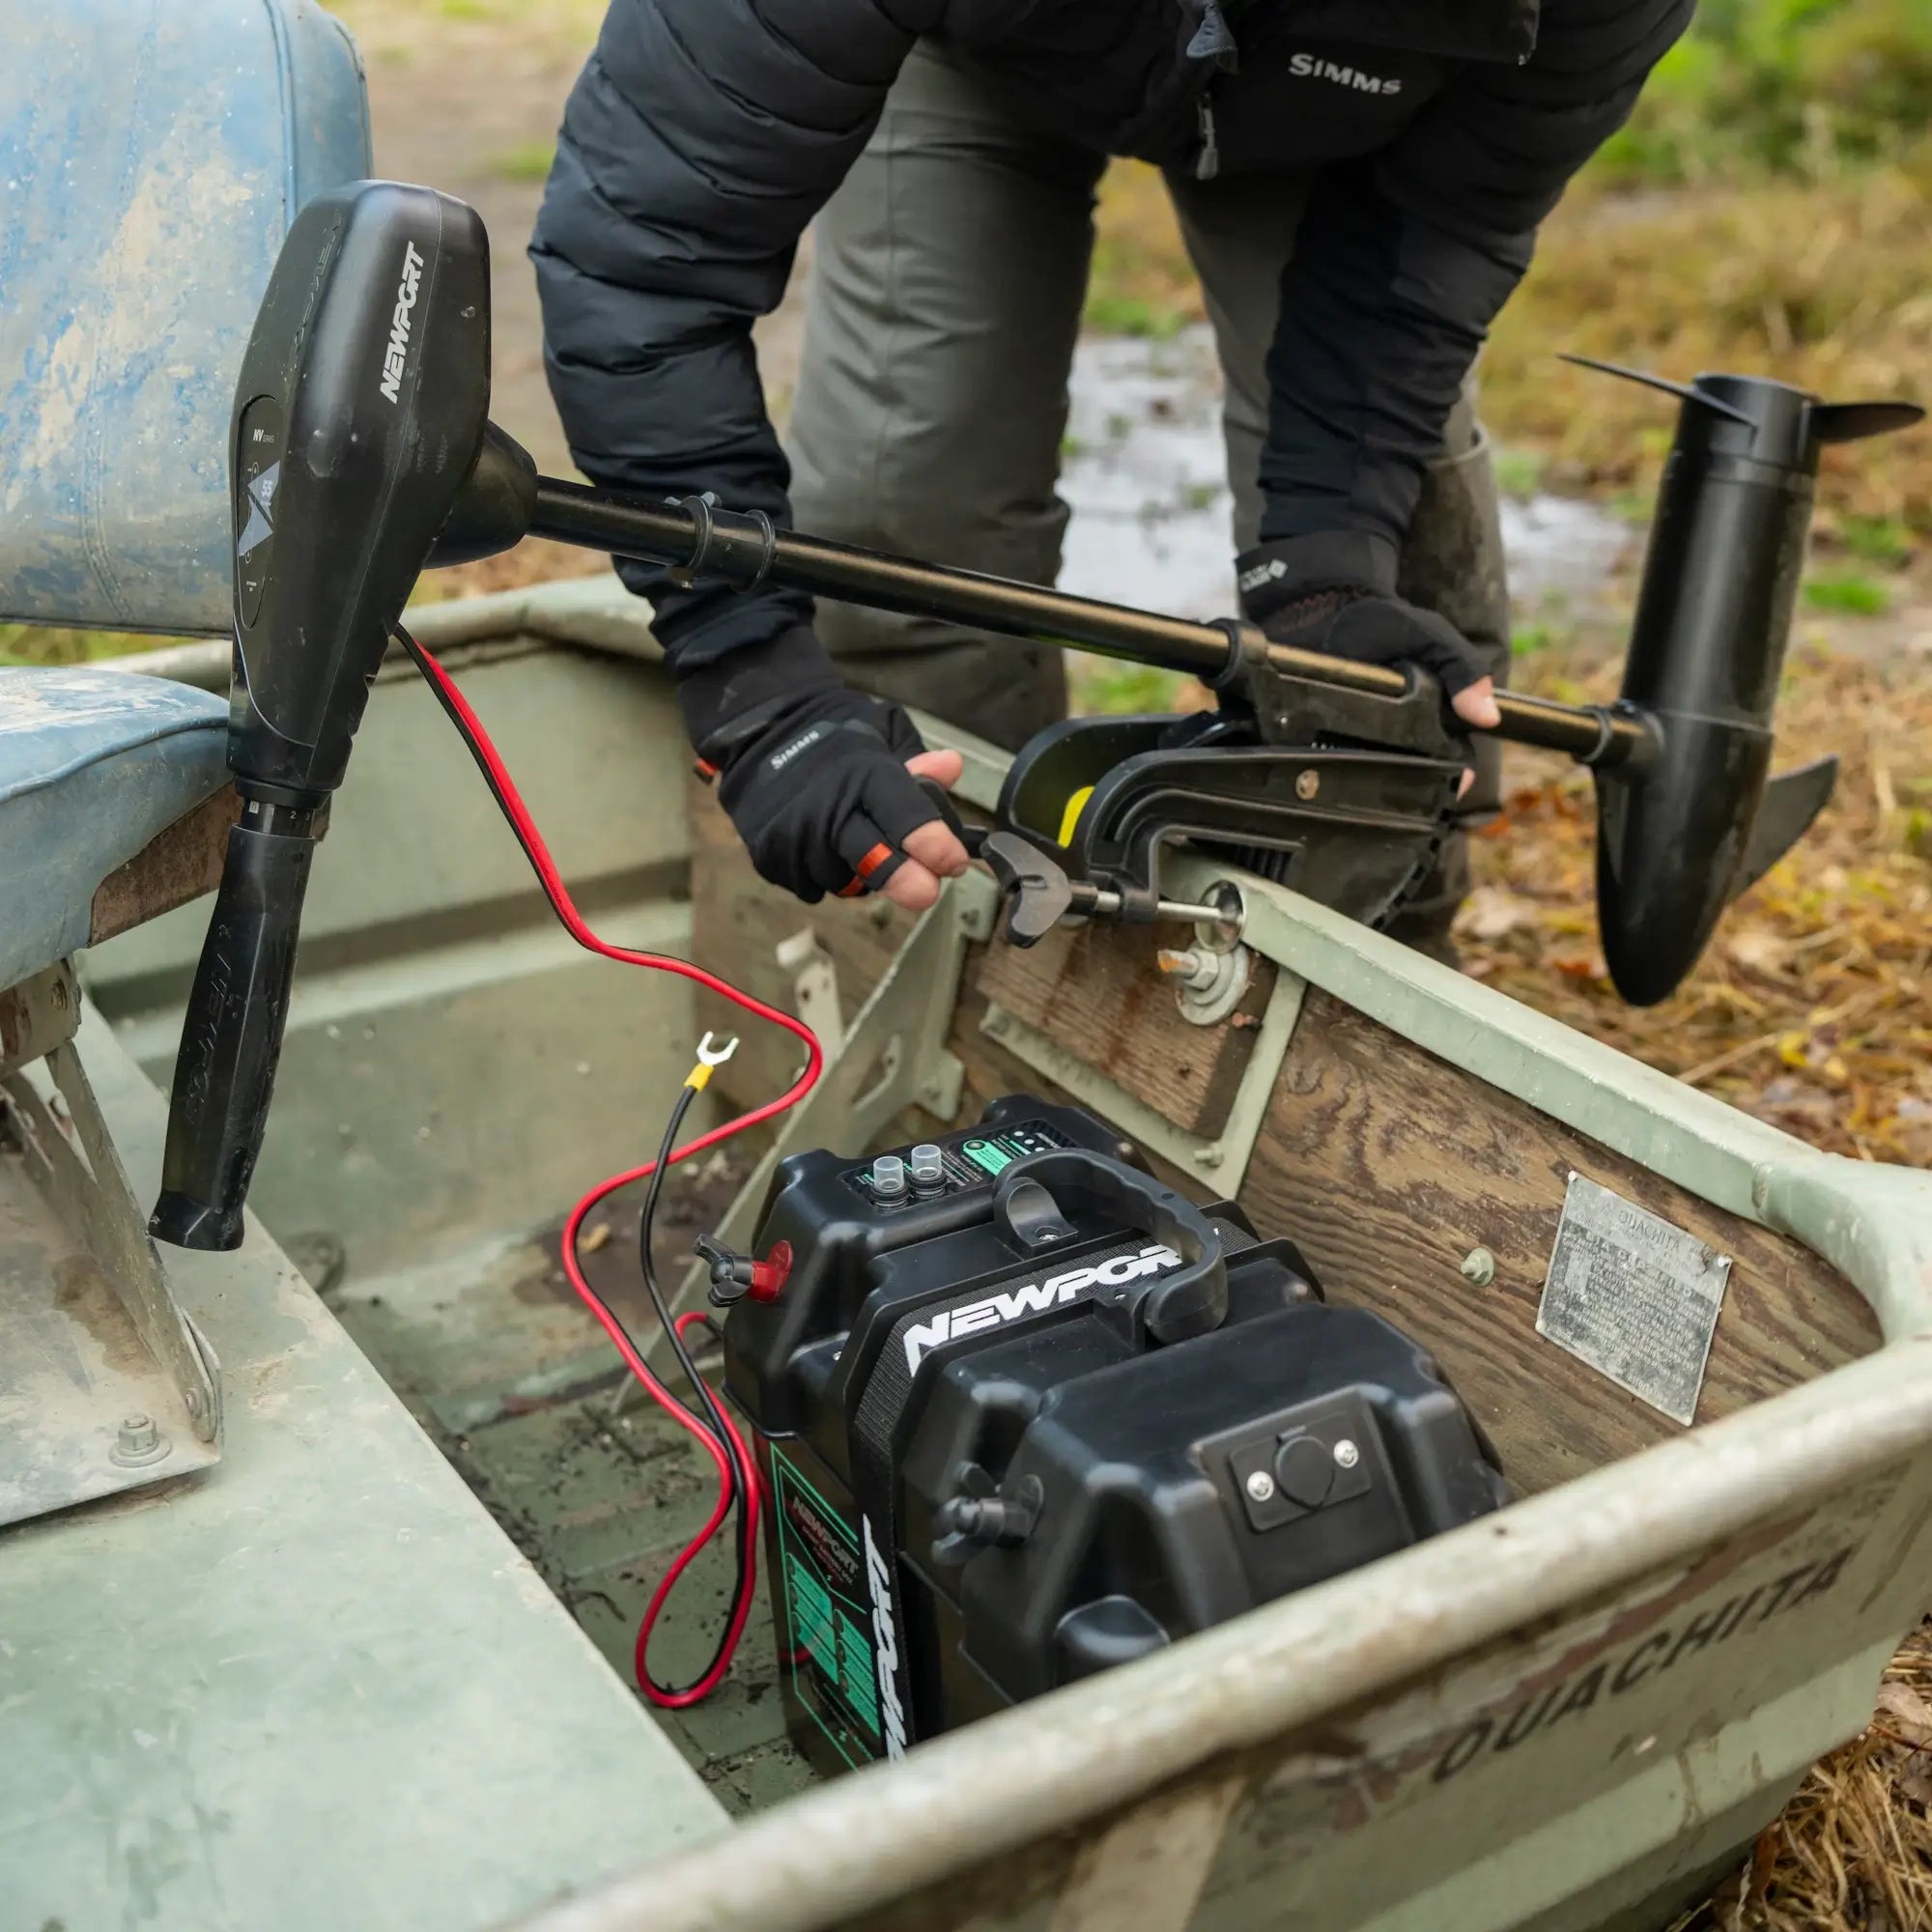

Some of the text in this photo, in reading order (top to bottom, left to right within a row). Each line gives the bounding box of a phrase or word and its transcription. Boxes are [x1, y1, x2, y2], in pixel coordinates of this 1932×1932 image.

[1289, 53, 1402, 95] SIMMS
[380, 240, 424, 404] NEWPORT
[290, 810, 297, 819] 2
[1619, 1210, 1679, 1253] OUACHITA
[903, 1244, 1182, 1378] NEWPOR
[1433, 1544, 1855, 1782] OUACHITA
